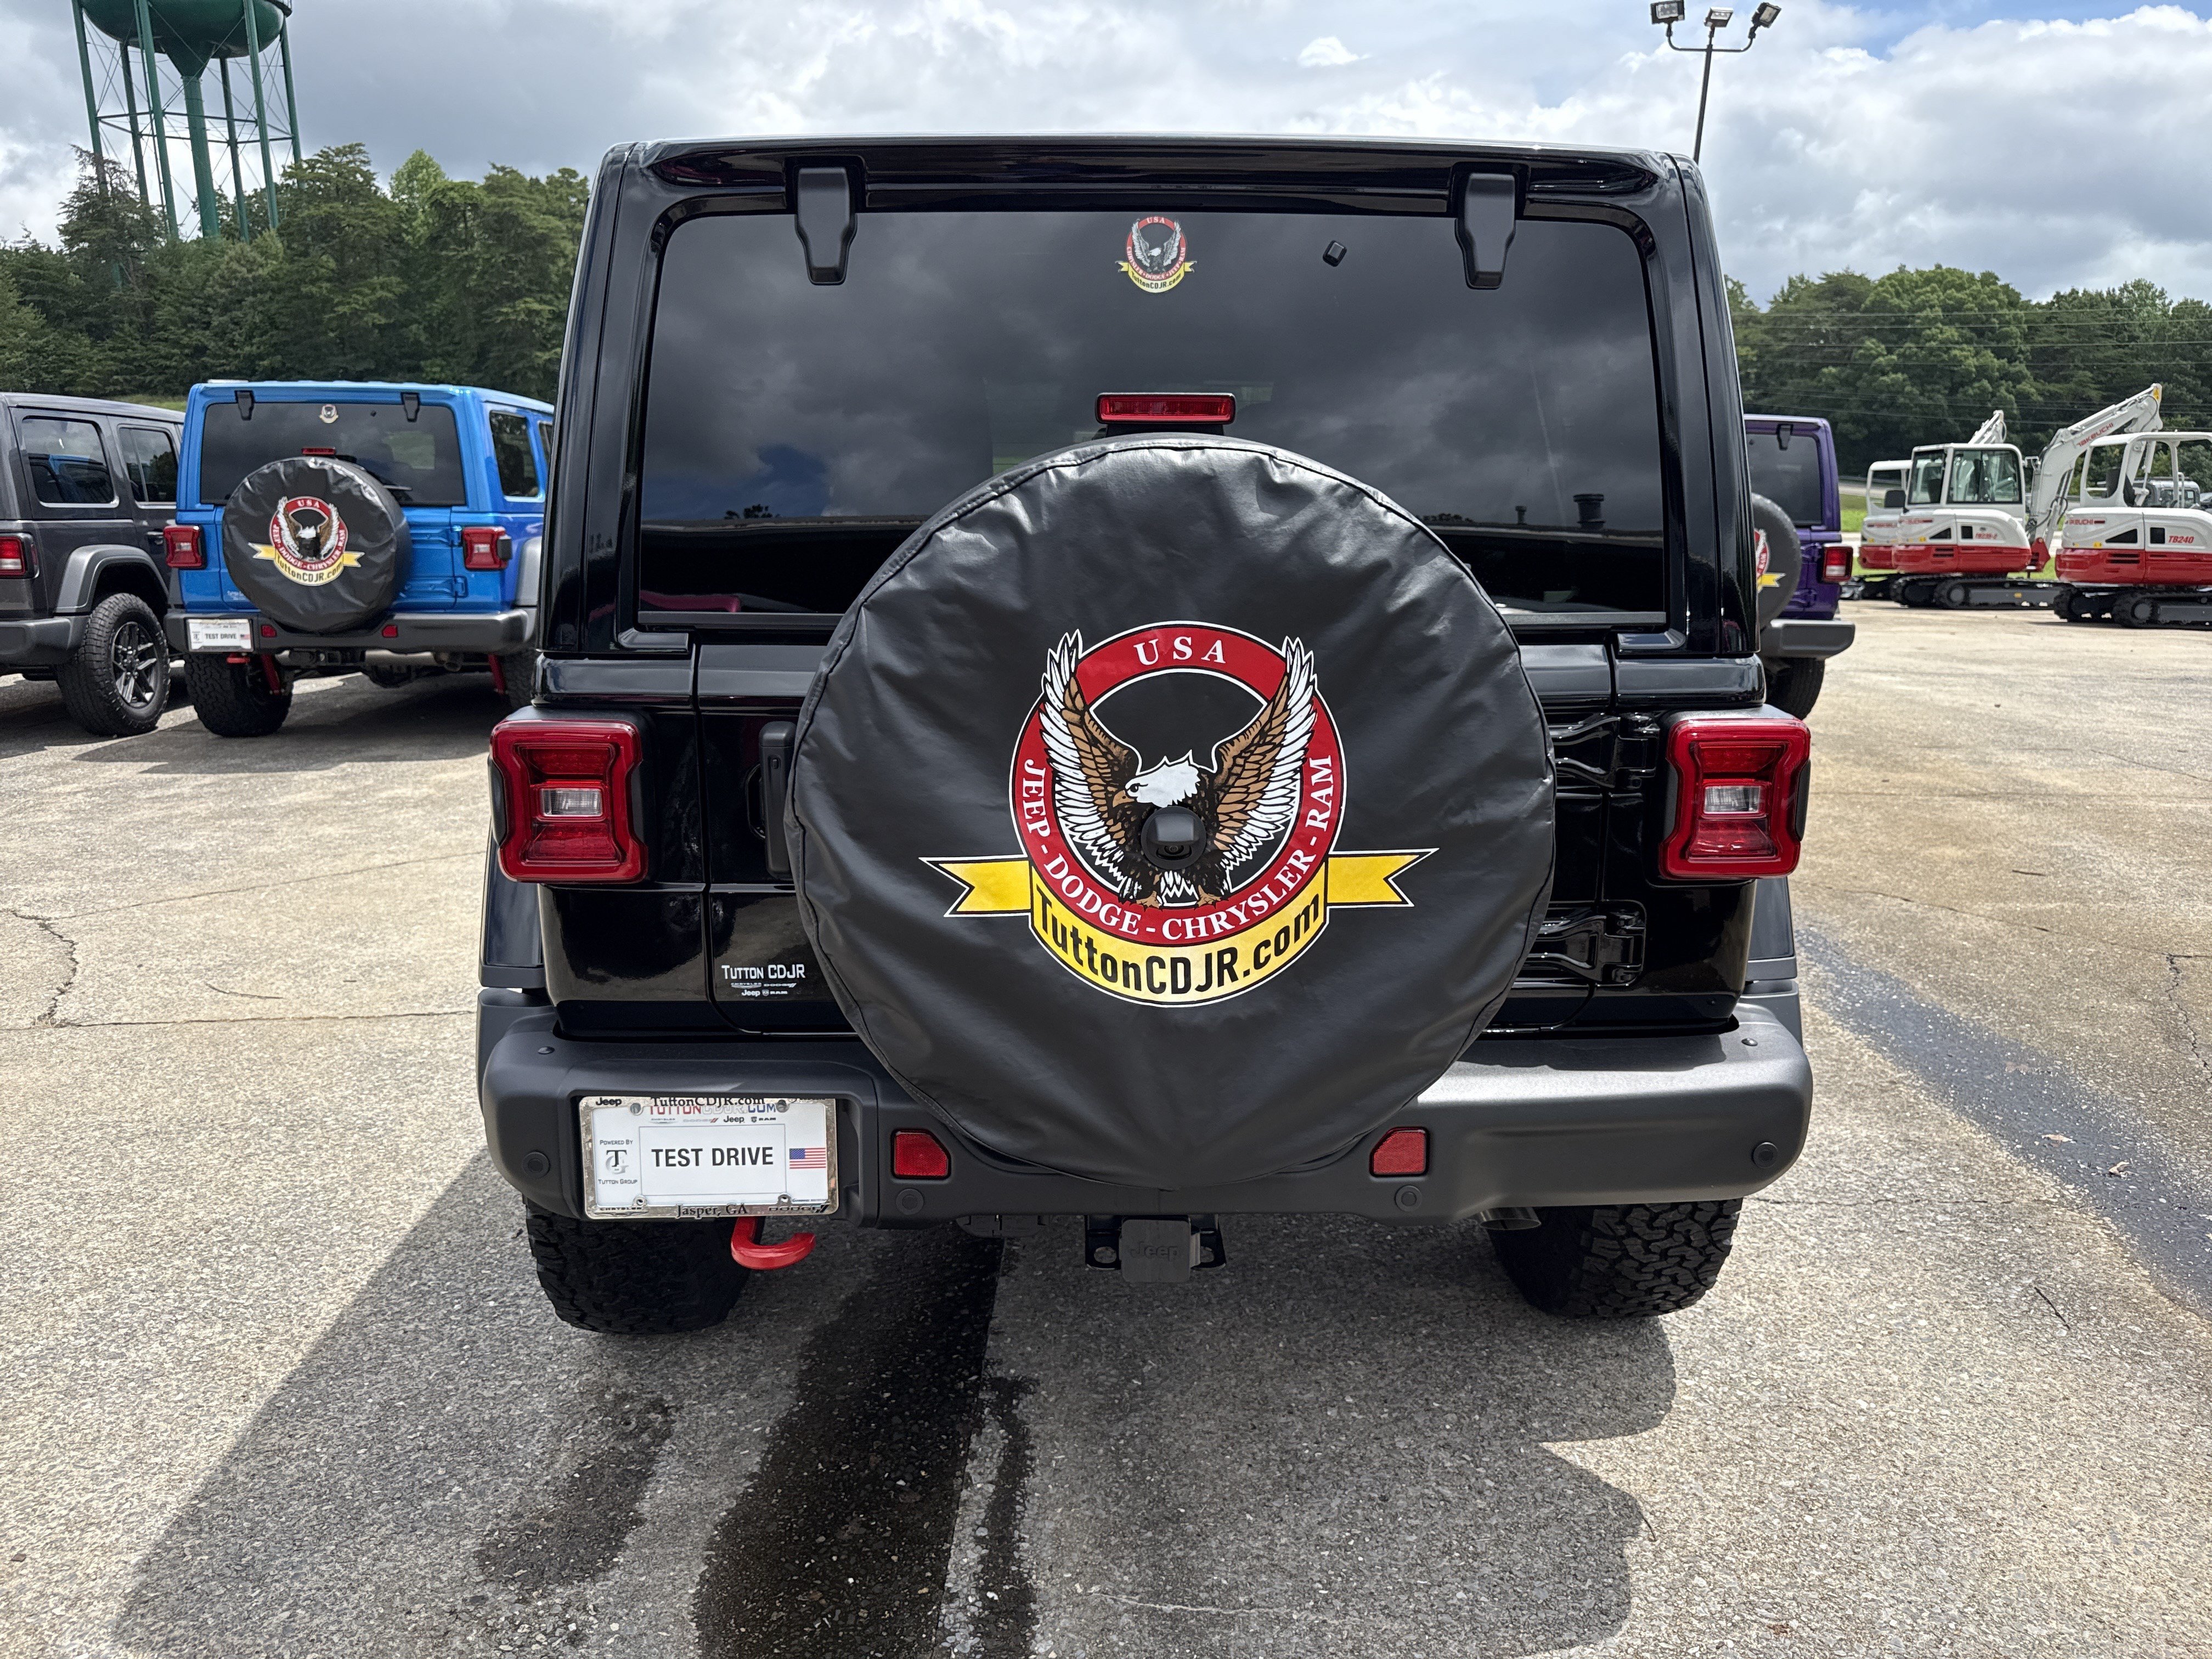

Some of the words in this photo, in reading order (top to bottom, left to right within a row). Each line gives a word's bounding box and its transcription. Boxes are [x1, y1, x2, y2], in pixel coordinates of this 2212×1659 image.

[1131, 270, 1181, 290] TuttonCDJR.com
[297, 499, 320, 509] USA
[2168, 535, 2194, 544] TB240
[1133, 635, 1227, 667] USA
[1025, 759, 1051, 838] JEEP
[1044, 861, 1139, 936] DODGE
[1162, 849, 1317, 941] CHRYSLER
[1306, 754, 1334, 833] RAM
[1034, 883, 1321, 995] TuttonCDJR.com
[768, 964, 806, 979] CDJR
[741, 989, 761, 997] Jeep
[595, 1097, 622, 1107] Jeep
[723, 1115, 744, 1124] Jeep
[651, 1148, 703, 1168] TEST
[713, 1147, 774, 1166] DRIVE
[676, 1204, 721, 1219] Jasper,
[725, 1203, 748, 1214] GA
[1130, 1241, 1179, 1261] Jeep
